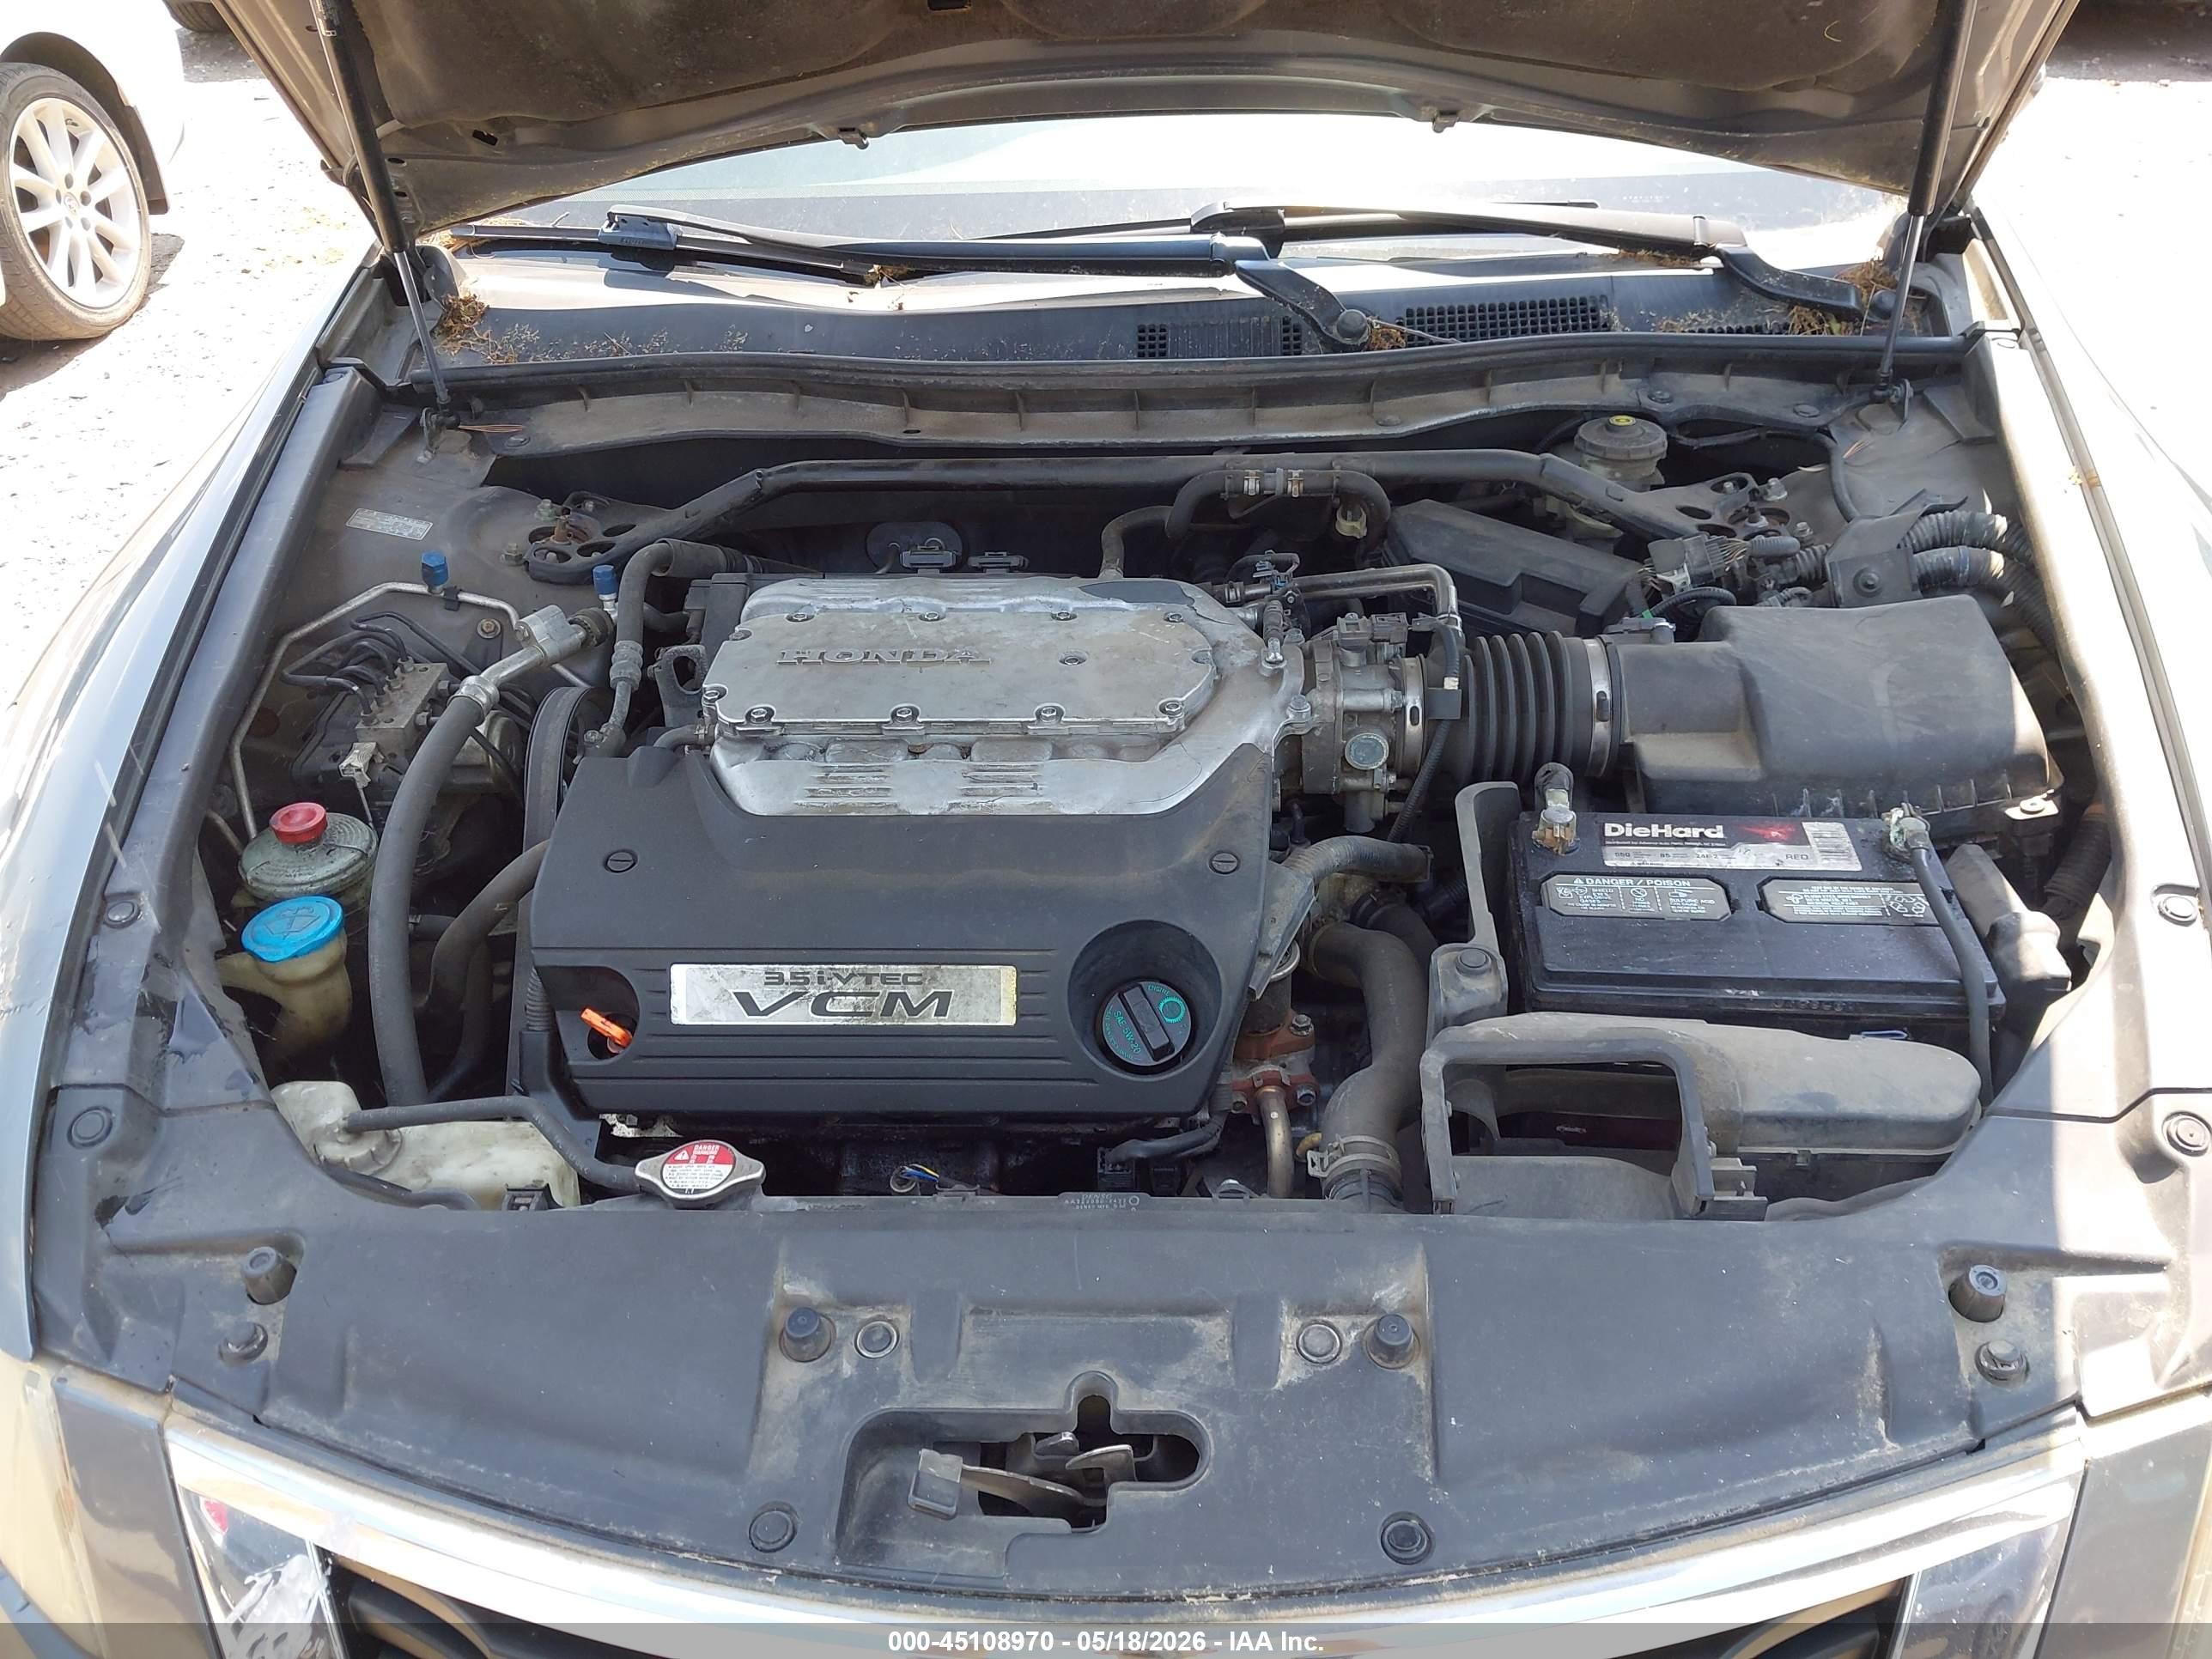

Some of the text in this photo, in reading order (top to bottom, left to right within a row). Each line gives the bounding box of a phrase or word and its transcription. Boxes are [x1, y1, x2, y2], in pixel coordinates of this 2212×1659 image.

[776, 649, 991, 665] HONDA
[1604, 823, 1724, 839] DieHard
[1147, 984, 1170, 996] ENGINE
[729, 990, 954, 1018] VCM
[1114, 1010, 1127, 1027] SAE
[1122, 1027, 1141, 1054] 5W-20
